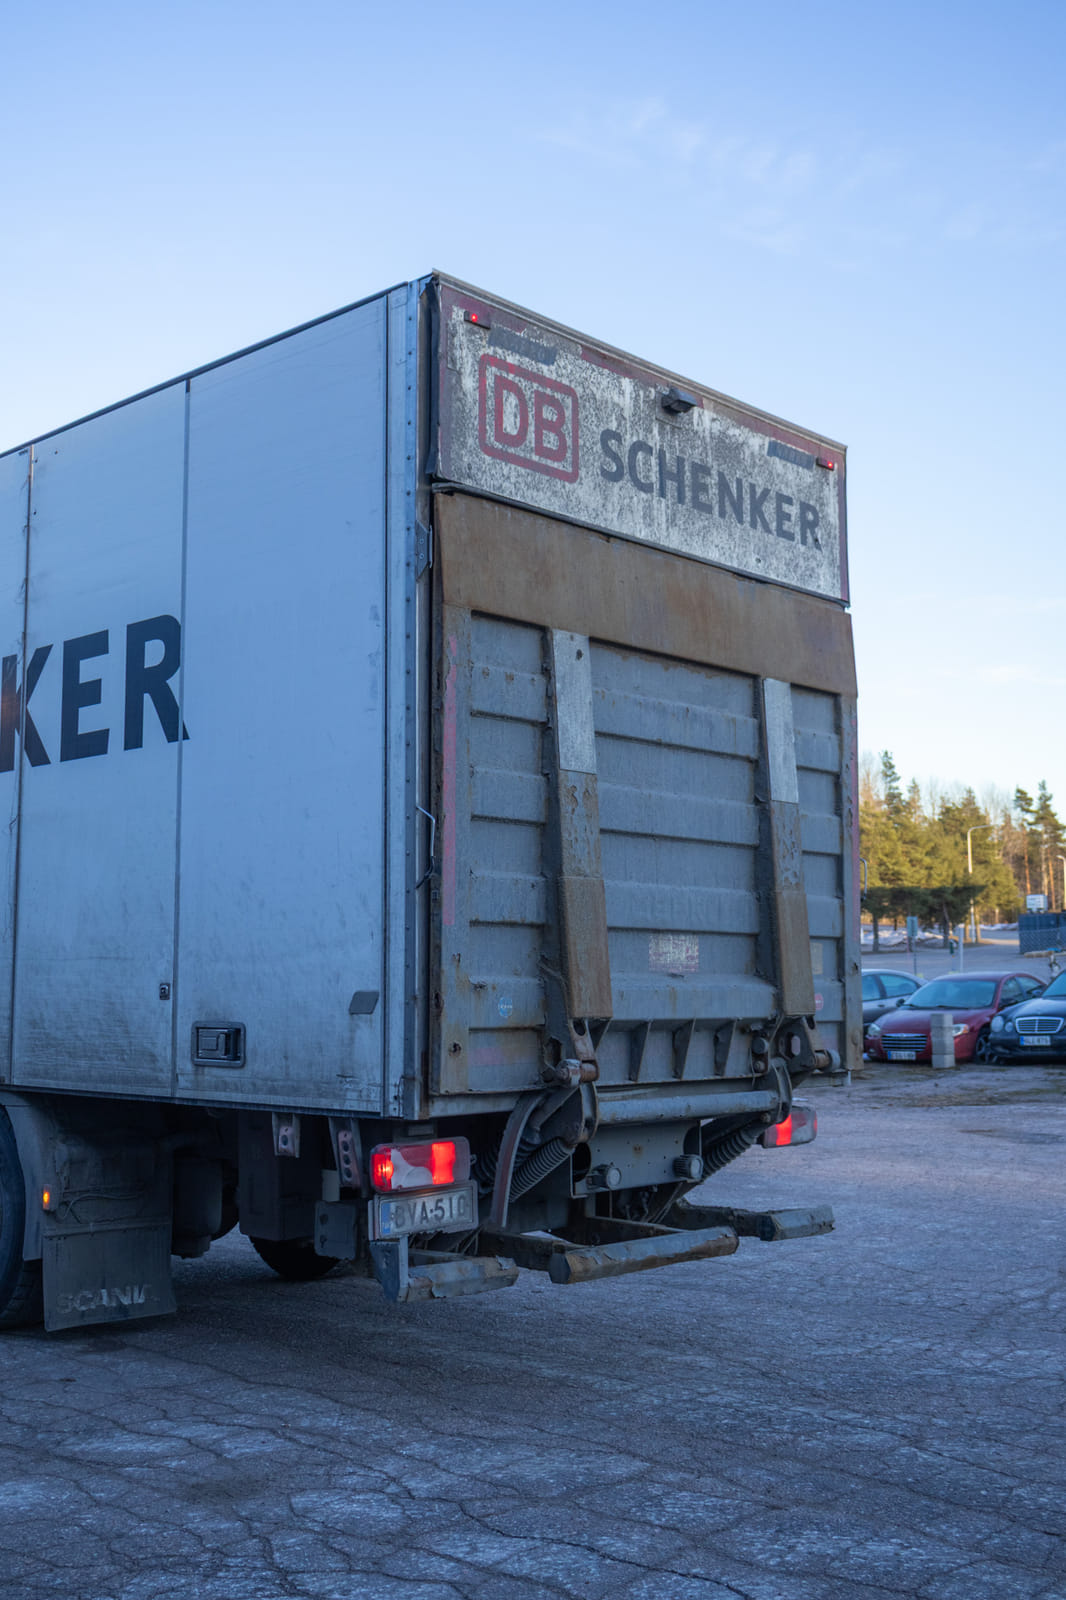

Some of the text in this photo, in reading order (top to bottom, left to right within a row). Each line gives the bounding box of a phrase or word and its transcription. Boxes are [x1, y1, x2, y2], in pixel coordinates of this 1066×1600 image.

[493, 373, 569, 465] DB
[599, 428, 823, 551] SCHENKER
[0, 614, 190, 774] KER
